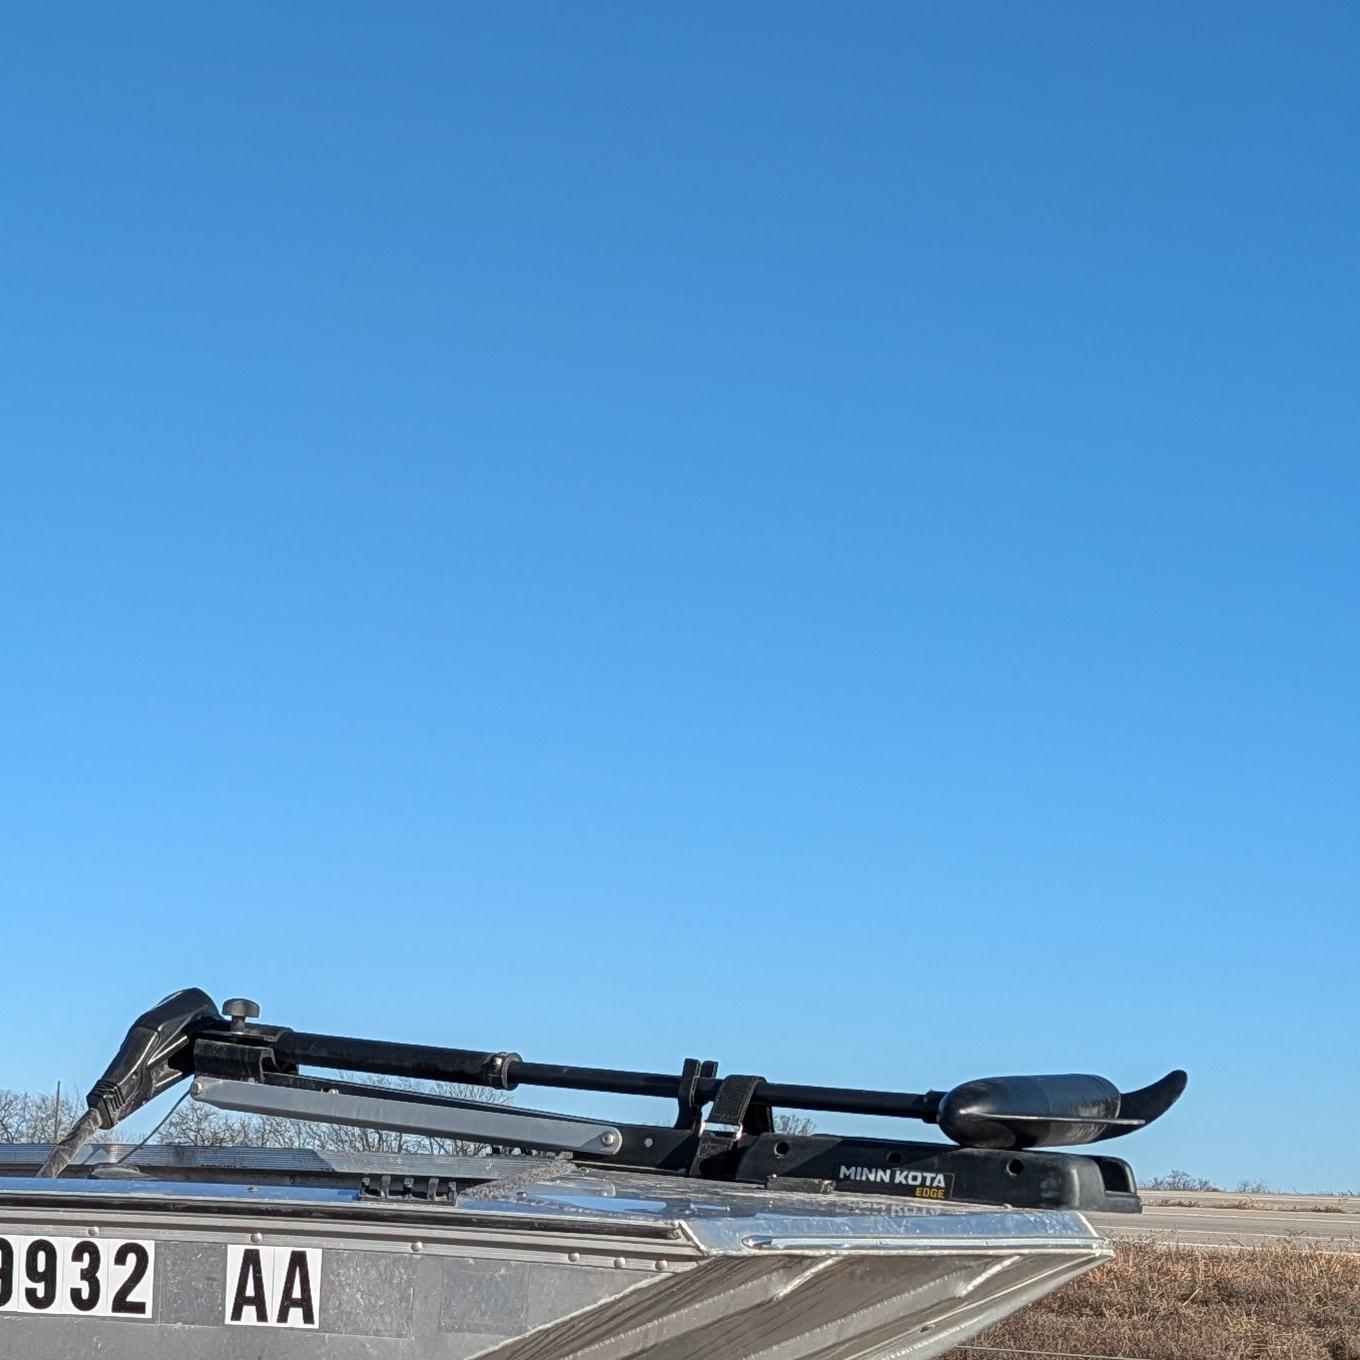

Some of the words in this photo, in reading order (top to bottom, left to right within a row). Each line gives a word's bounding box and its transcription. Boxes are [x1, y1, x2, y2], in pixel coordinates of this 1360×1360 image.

[839, 1165, 891, 1183] MINN
[894, 1170, 946, 1188] KOTA
[915, 1187, 945, 1199] EDGE
[231, 1248, 316, 1325] AA
